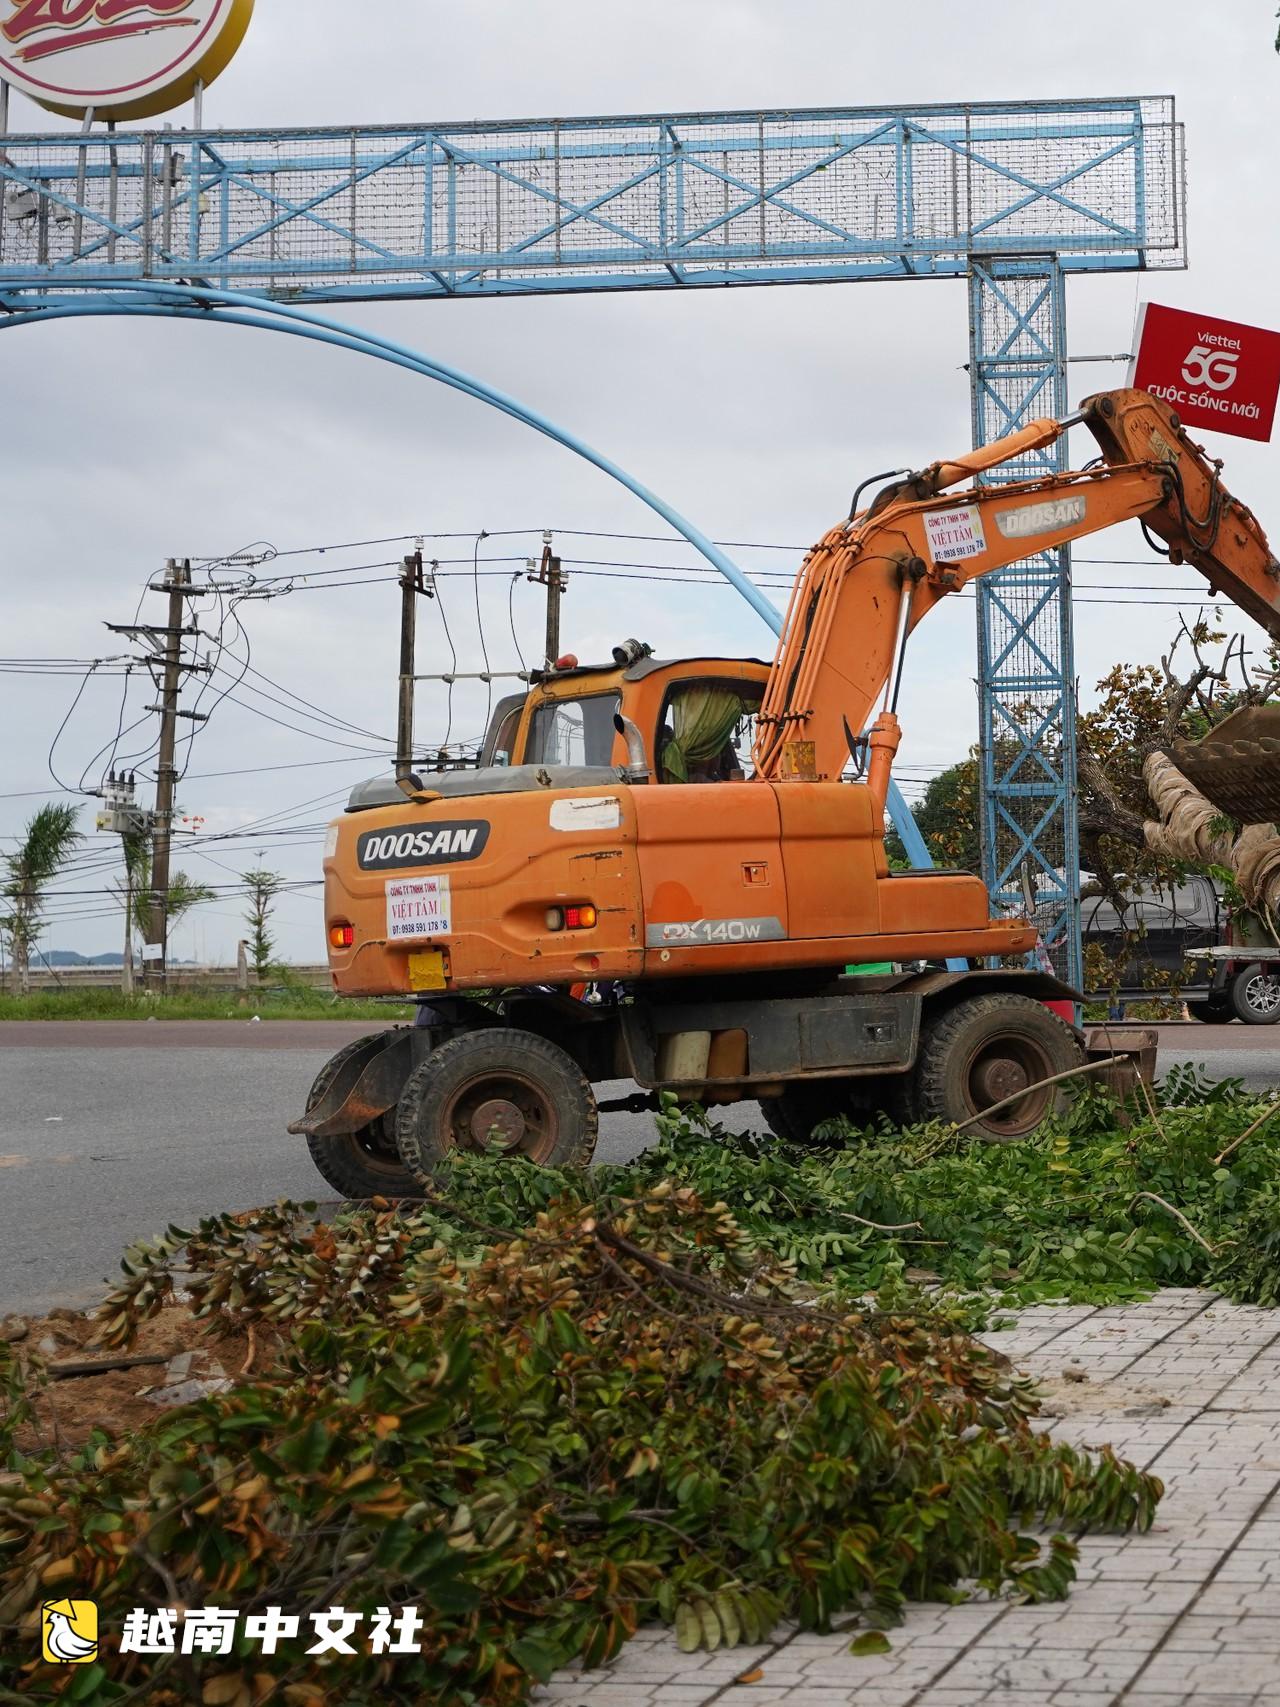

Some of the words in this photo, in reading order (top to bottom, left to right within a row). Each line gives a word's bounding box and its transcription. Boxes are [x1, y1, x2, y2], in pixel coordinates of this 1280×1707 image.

[1197, 332, 1241, 350] viettel
[1181, 345, 1240, 391] 5G
[1188, 391, 1229, 412] SỐNG
[1231, 402, 1260, 419] MỚI
[1006, 502, 1080, 532] DOOSAN
[931, 529, 951, 546] VIỆT
[363, 829, 478, 862] DOOSAN
[392, 899, 412, 920] VIỆT
[401, 923, 414, 934] 0938
[416, 922, 426, 932] 591
[428, 920, 439, 931] 178
